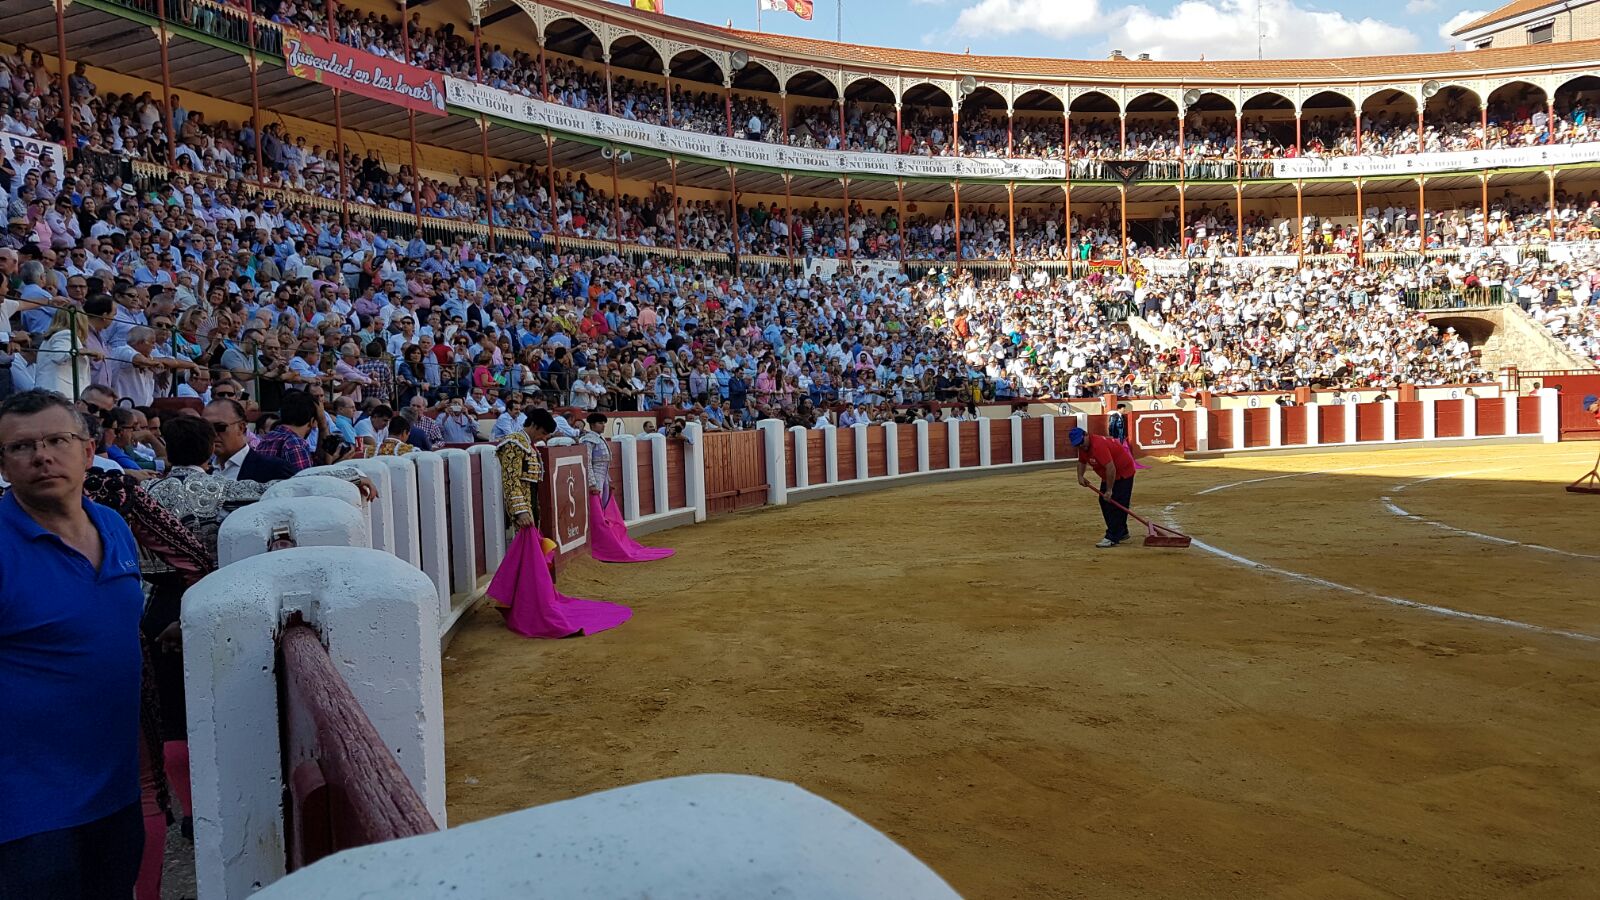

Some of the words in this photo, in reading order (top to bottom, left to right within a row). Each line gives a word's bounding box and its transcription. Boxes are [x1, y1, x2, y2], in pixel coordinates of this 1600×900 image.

[287, 39, 353, 79] Juventud
[353, 69, 371, 84] en
[372, 67, 393, 91] los
[394, 74, 431, 101] toros
[466, 94, 514, 114] NUBORI
[539, 112, 586, 131] NUBORI
[606, 126, 651, 141] NUBORI
[669, 139, 712, 153] NUBORI
[730, 149, 770, 161] NUBORI
[784, 156, 831, 167] NUBORI
[849, 161, 890, 170] NUBORI
[906, 164, 948, 173] NUBORI
[965, 167, 1005, 175] NUBORI
[1352, 394, 1357, 403] 6
[1451, 390, 1457, 399] 6
[1153, 402, 1159, 411] 6
[1251, 398, 1256, 407] 6
[1062, 405, 1067, 415] 6
[616, 422, 621, 435] 7
[1153, 422, 1162, 437] S
[568, 481, 576, 518] S
